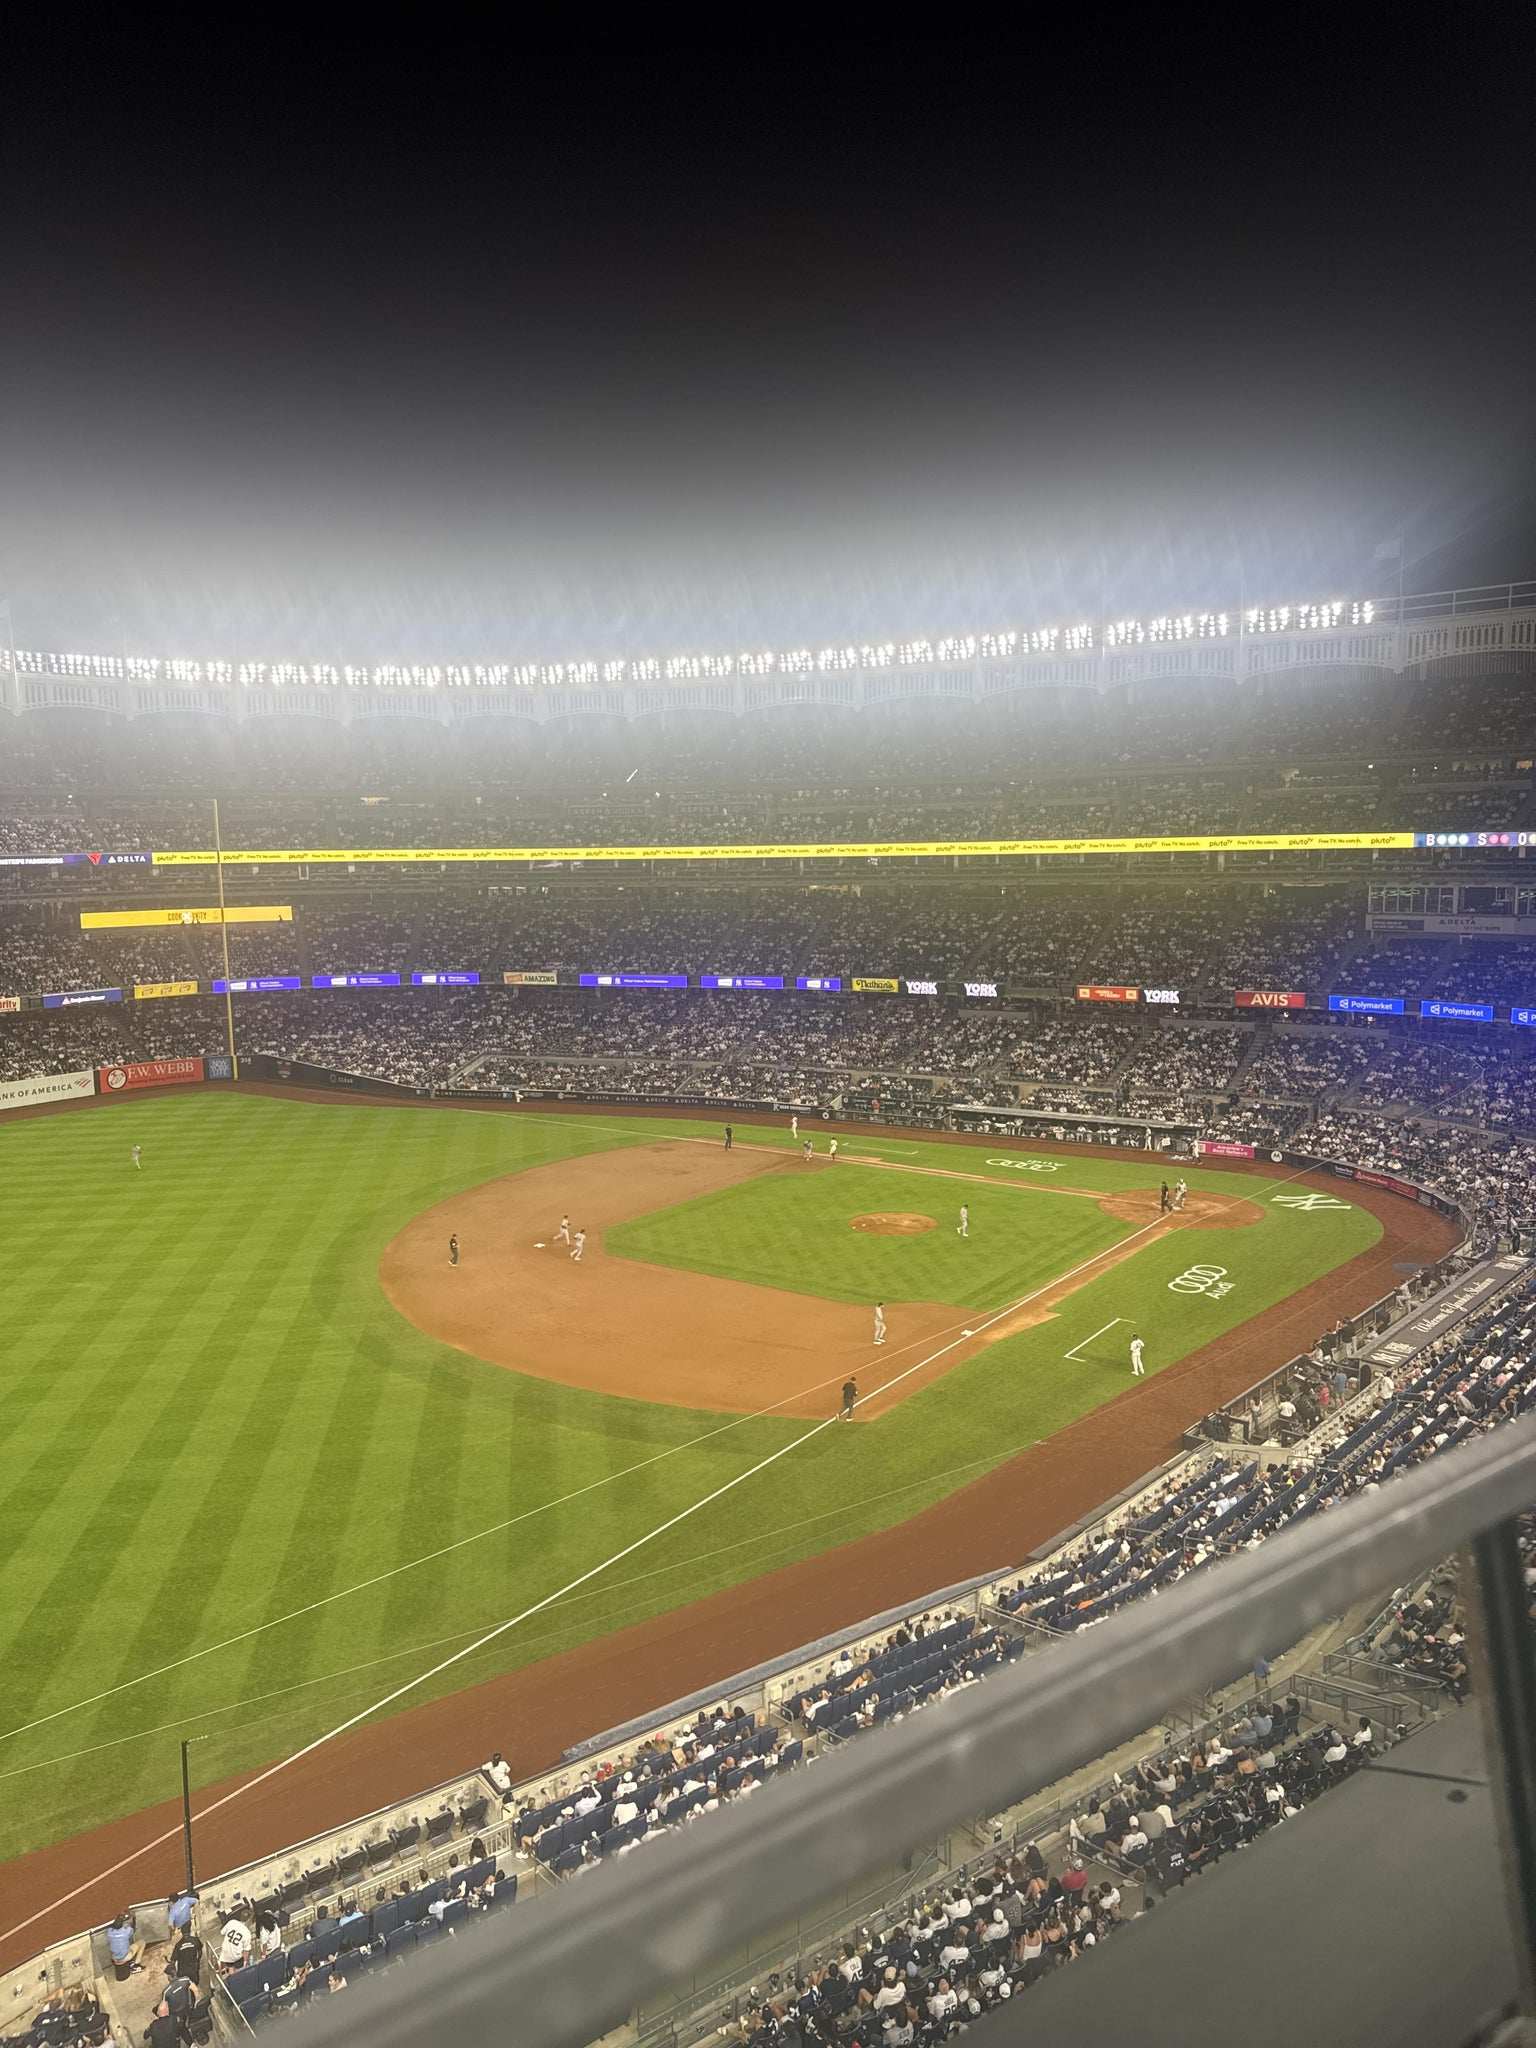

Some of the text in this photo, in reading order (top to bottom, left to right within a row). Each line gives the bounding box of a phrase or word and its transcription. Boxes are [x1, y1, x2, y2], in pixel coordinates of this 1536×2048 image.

[1427, 834, 1436, 846] B
[1478, 834, 1487, 845] S
[117, 855, 147, 863] DELTA
[525, 975, 556, 983] AMAZING
[906, 981, 938, 992] YORK
[964, 983, 997, 994] YORK
[1144, 989, 1180, 1001] YORK
[1251, 994, 1289, 1006] AVIS
[1351, 1001, 1393, 1011] Polymarket
[1443, 1006, 1484, 1017] Polymarket
[128, 1066, 151, 1079] F.W.
[154, 1061, 194, 1075] WEBB
[0, 1083, 73, 1100] NK OF AMERICA
[1204, 1280, 1237, 1300] Audi
[227, 1929, 243, 1946] 42
